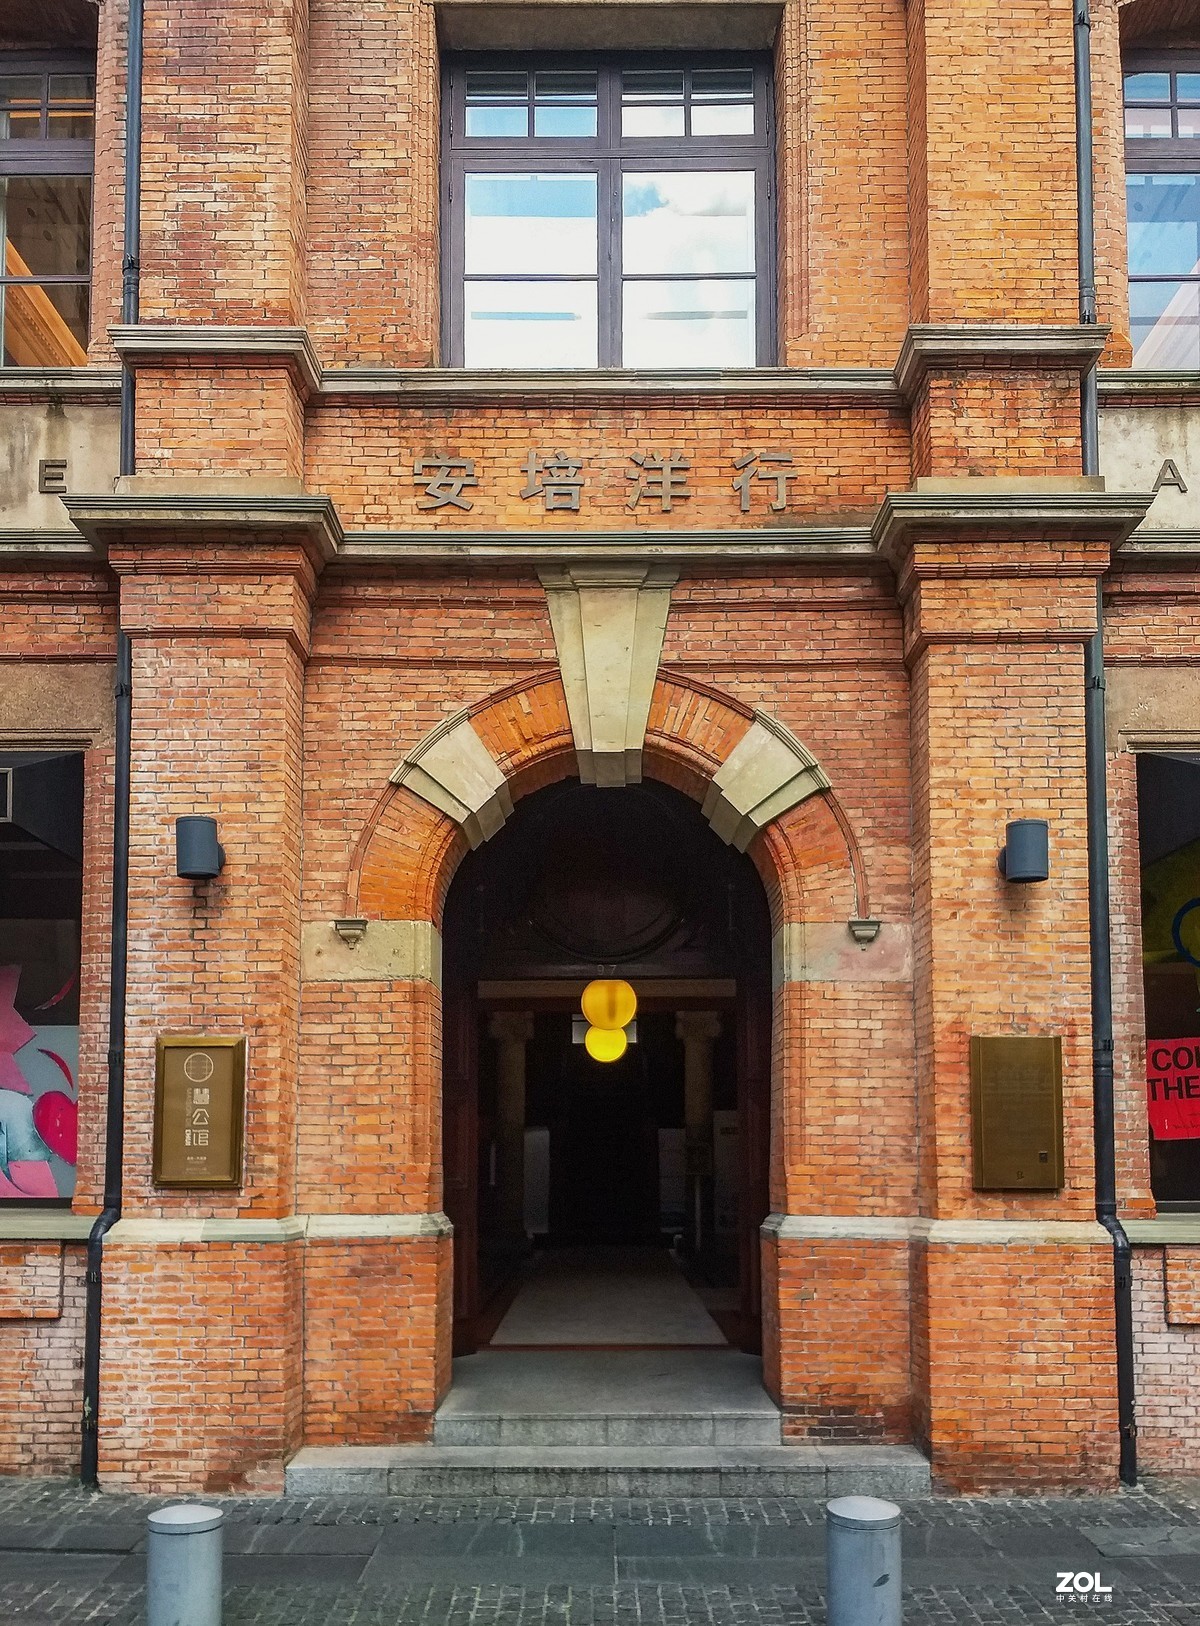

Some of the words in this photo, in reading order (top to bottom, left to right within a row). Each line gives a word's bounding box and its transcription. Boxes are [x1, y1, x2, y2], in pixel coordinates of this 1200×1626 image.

[39, 459, 67, 493] E
[413, 451, 798, 512] 安培洋行
[1152, 459, 1189, 494] A
[597, 964, 617, 976] 97
